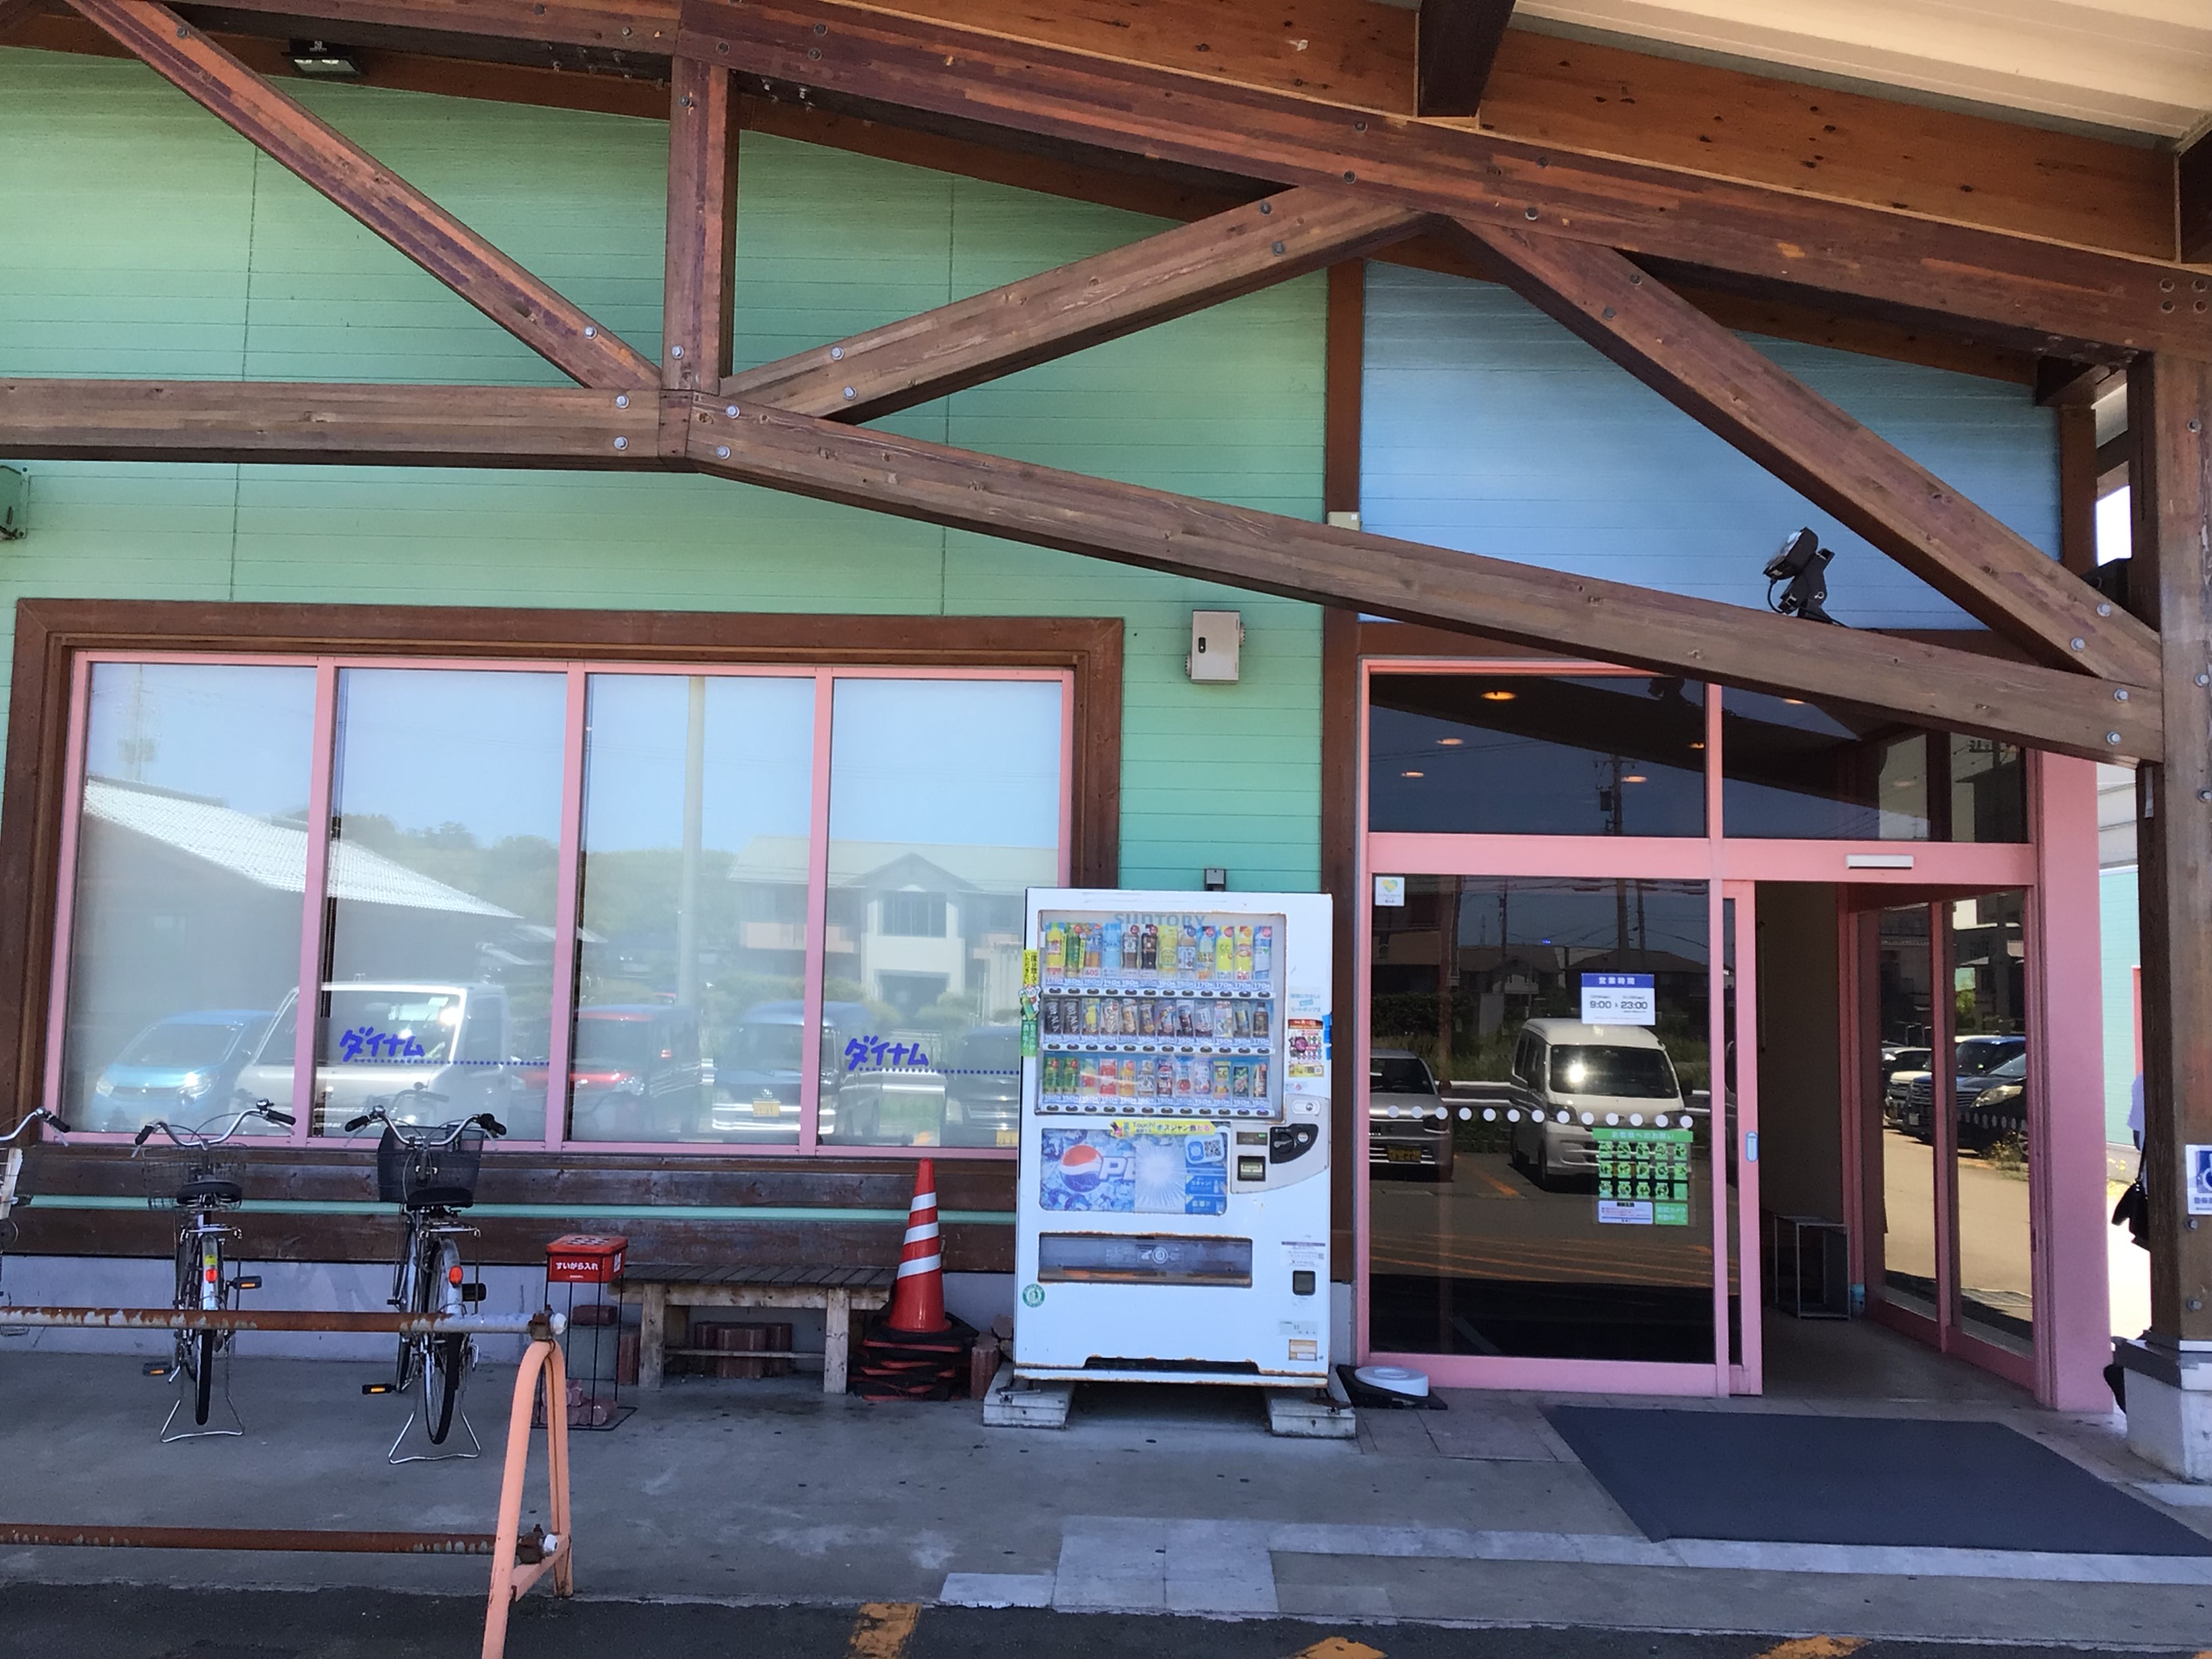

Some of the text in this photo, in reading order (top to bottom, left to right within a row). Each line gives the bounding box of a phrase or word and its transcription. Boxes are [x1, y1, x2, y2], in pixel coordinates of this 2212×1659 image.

[1590, 1000, 1647, 1010] 9:00 23:00
[340, 1027, 426, 1063] ダイナム
[844, 1036, 929, 1071] ダイナム
[556, 1262, 598, 1271] すいがら入れ
